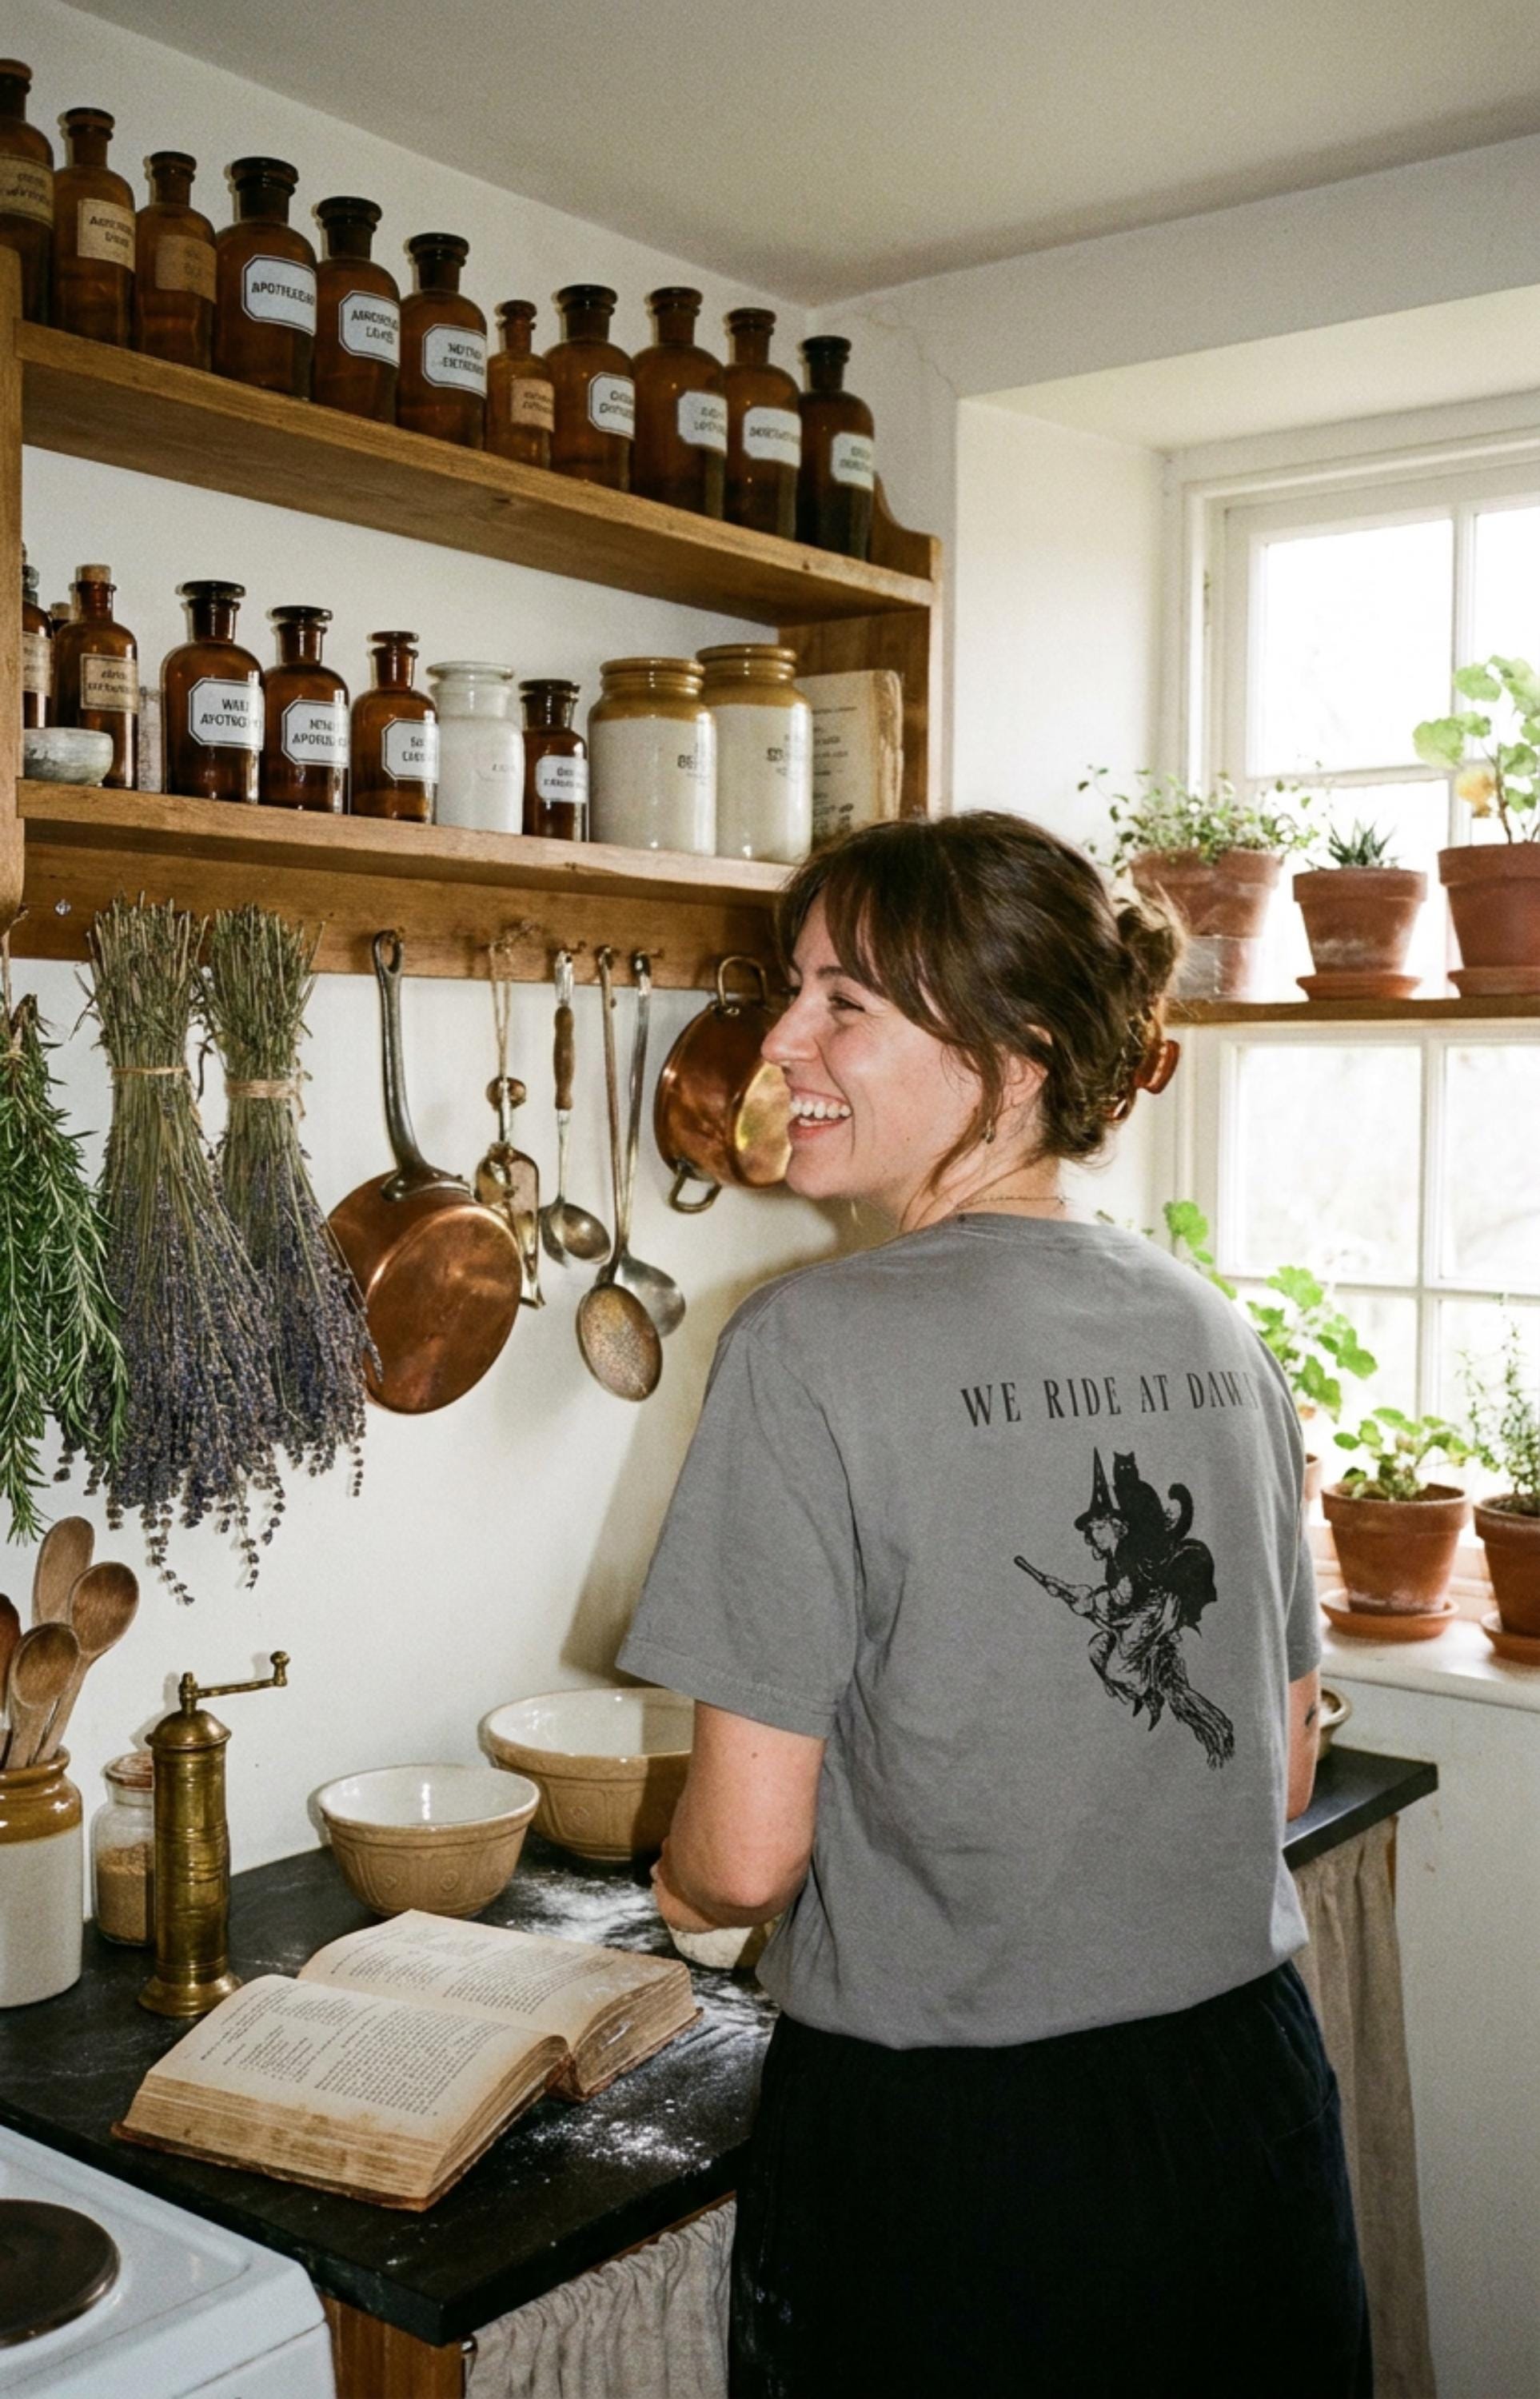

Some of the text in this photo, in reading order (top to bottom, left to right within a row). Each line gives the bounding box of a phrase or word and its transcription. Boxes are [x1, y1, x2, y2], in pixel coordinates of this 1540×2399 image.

[961, 1383, 1021, 1427] WE
[1043, 1376, 1121, 1419] RIDE
[1139, 1375, 1169, 1414] AT
